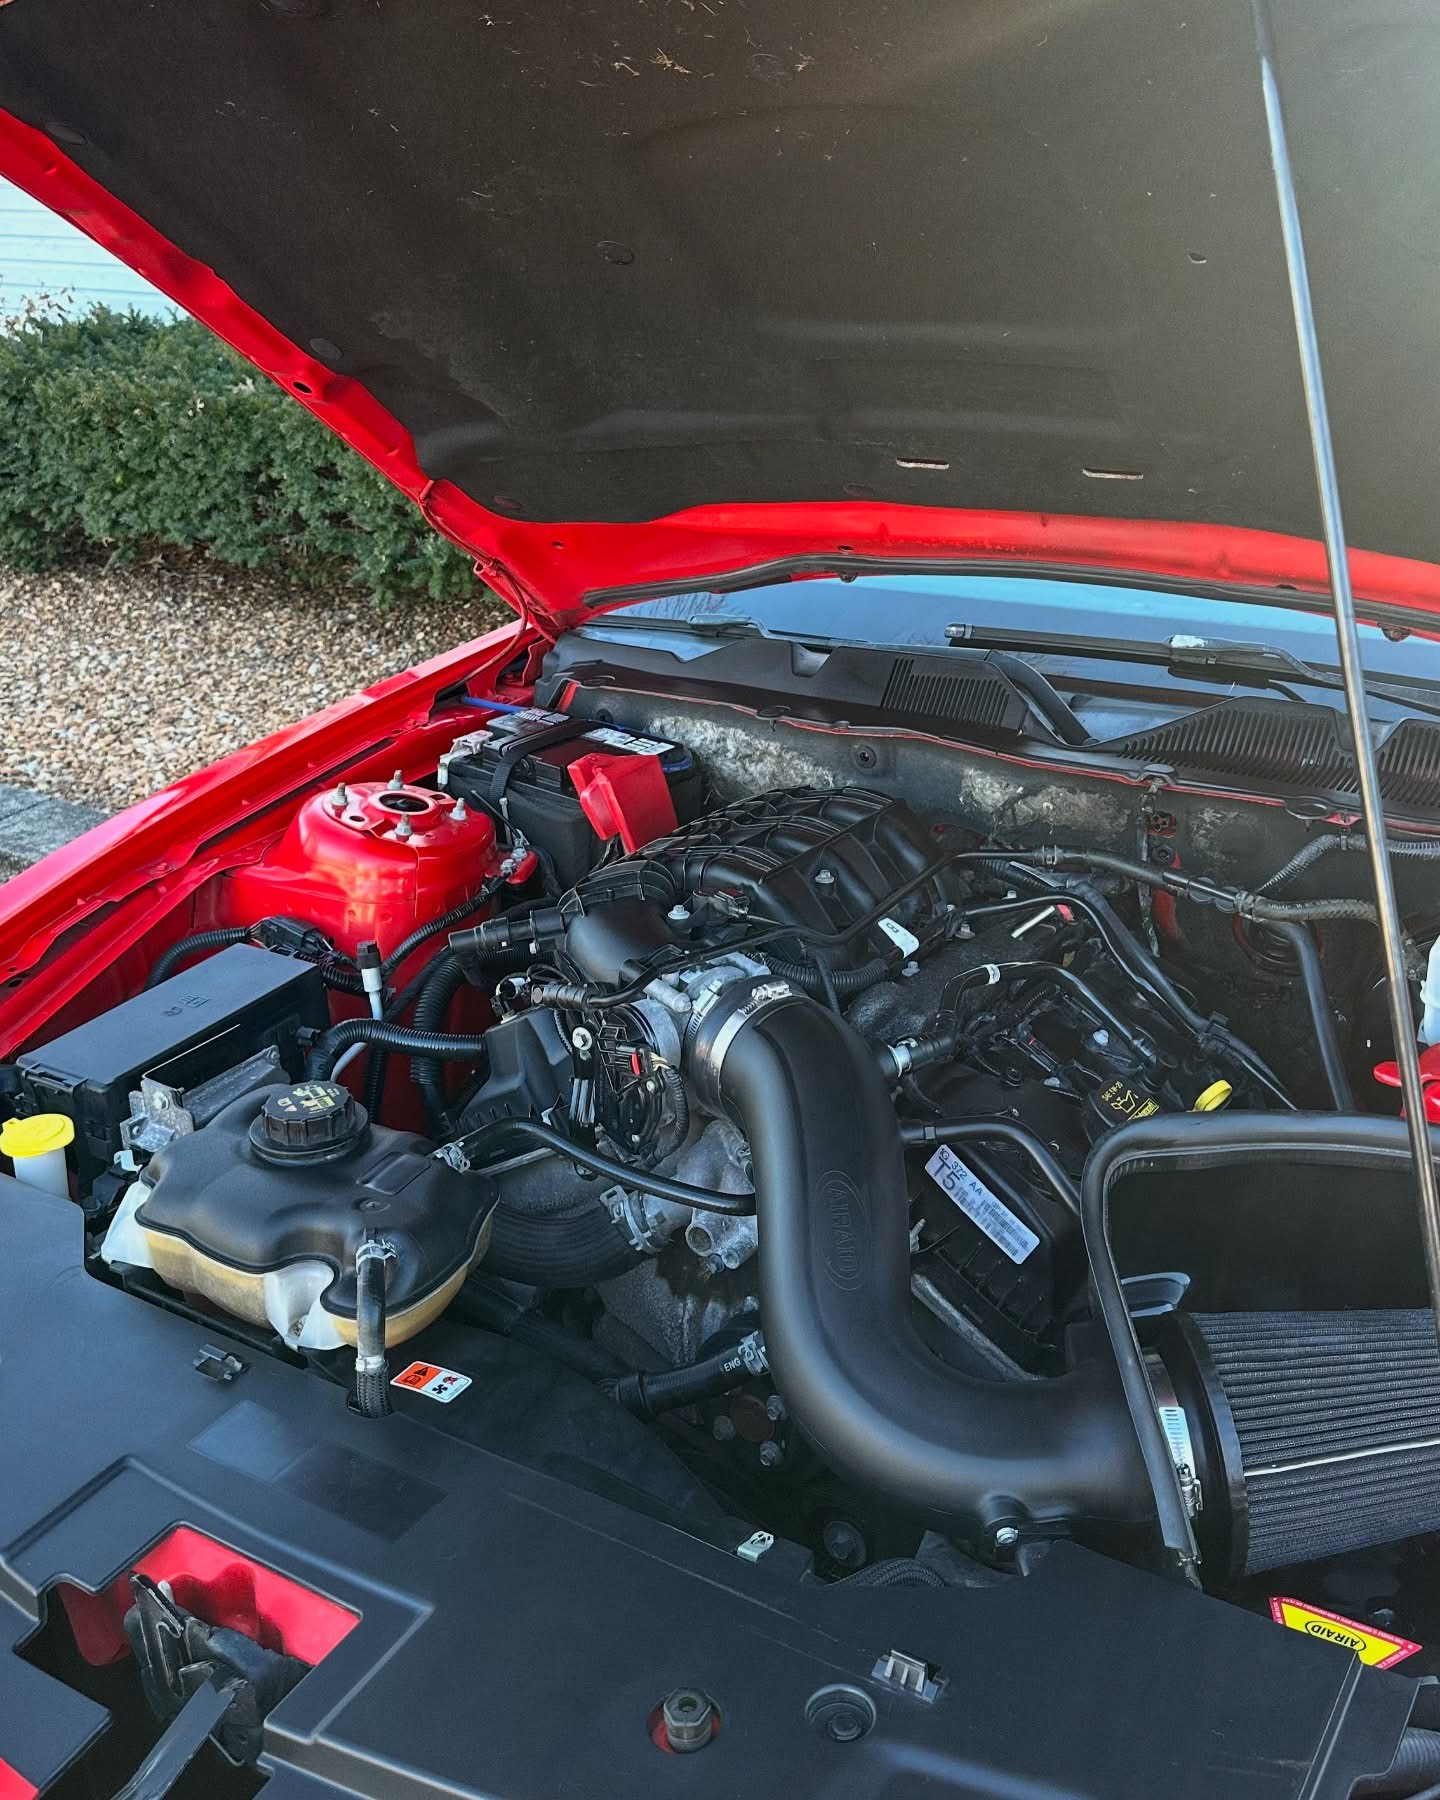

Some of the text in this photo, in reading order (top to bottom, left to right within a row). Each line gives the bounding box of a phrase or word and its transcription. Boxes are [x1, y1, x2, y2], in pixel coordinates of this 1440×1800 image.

[933, 1155, 956, 1190] T5
[951, 1161, 968, 1180] 372
[969, 1181, 983, 1196] AA
[723, 1356, 742, 1372] ENG
[1310, 1624, 1360, 1647] AIRAID
